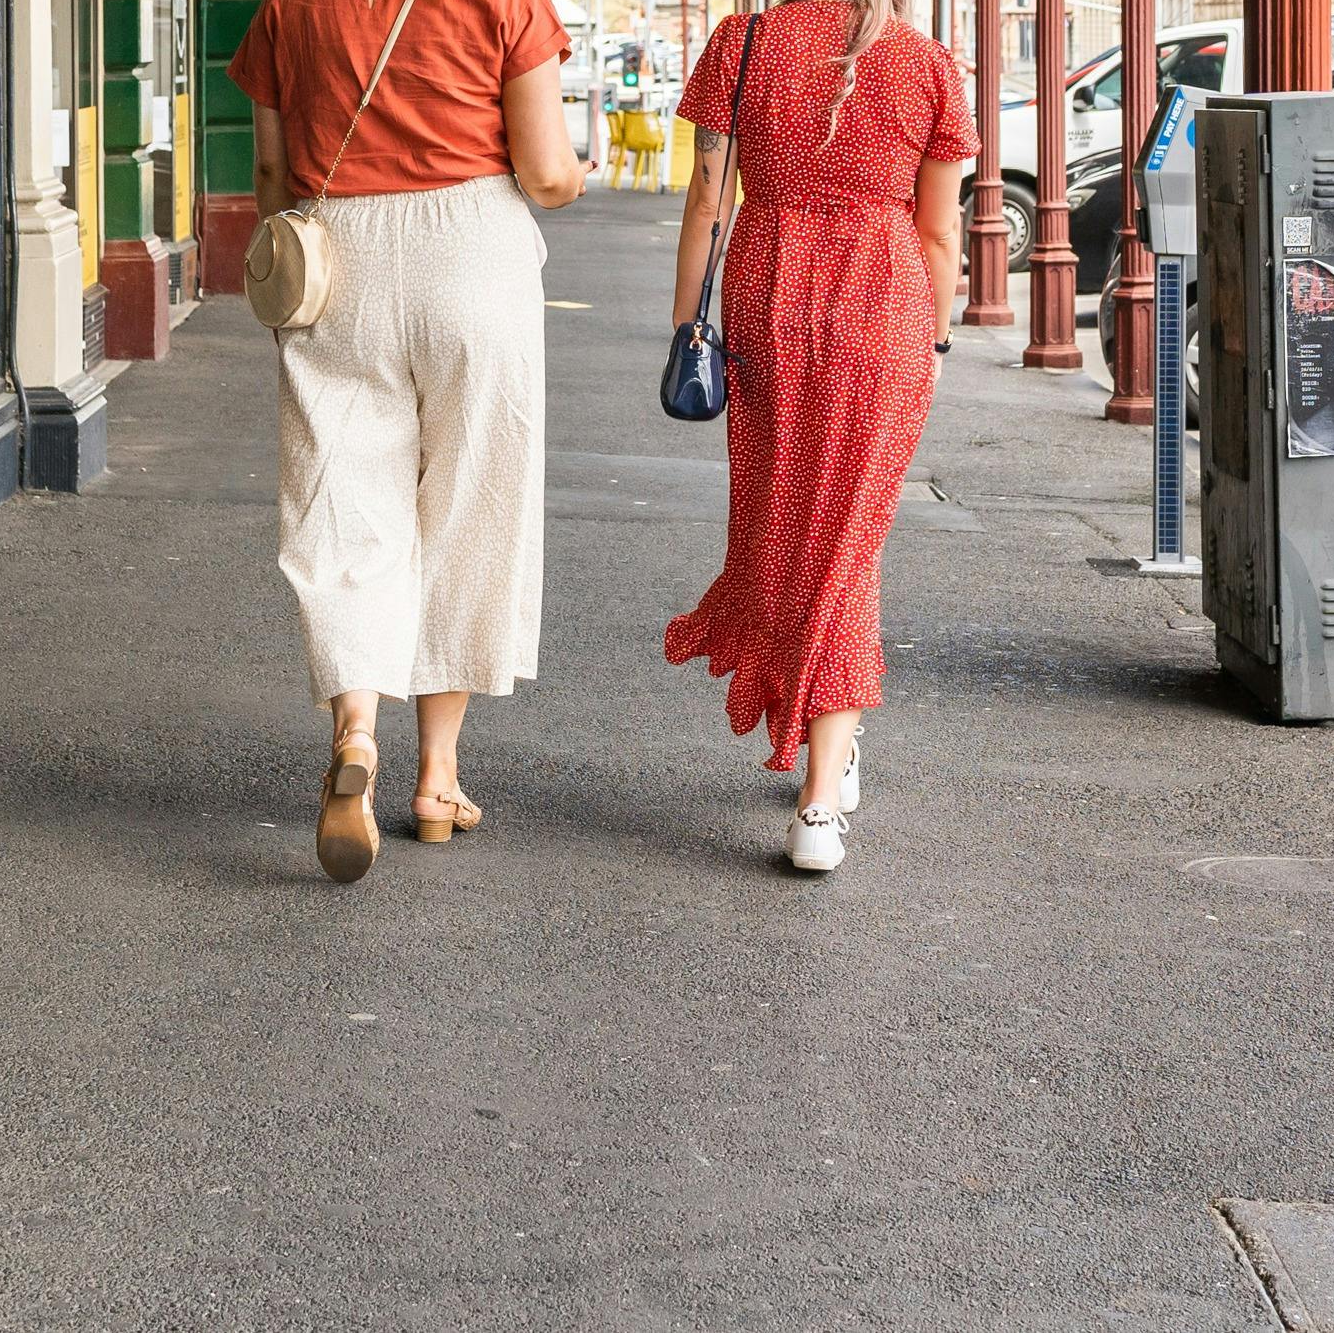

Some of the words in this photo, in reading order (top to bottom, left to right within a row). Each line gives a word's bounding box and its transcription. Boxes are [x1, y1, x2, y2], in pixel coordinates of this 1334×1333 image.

[1163, 120, 1176, 138] PAY
[1170, 97, 1185, 120] HERE
[1287, 246, 1301, 254] SCAN
